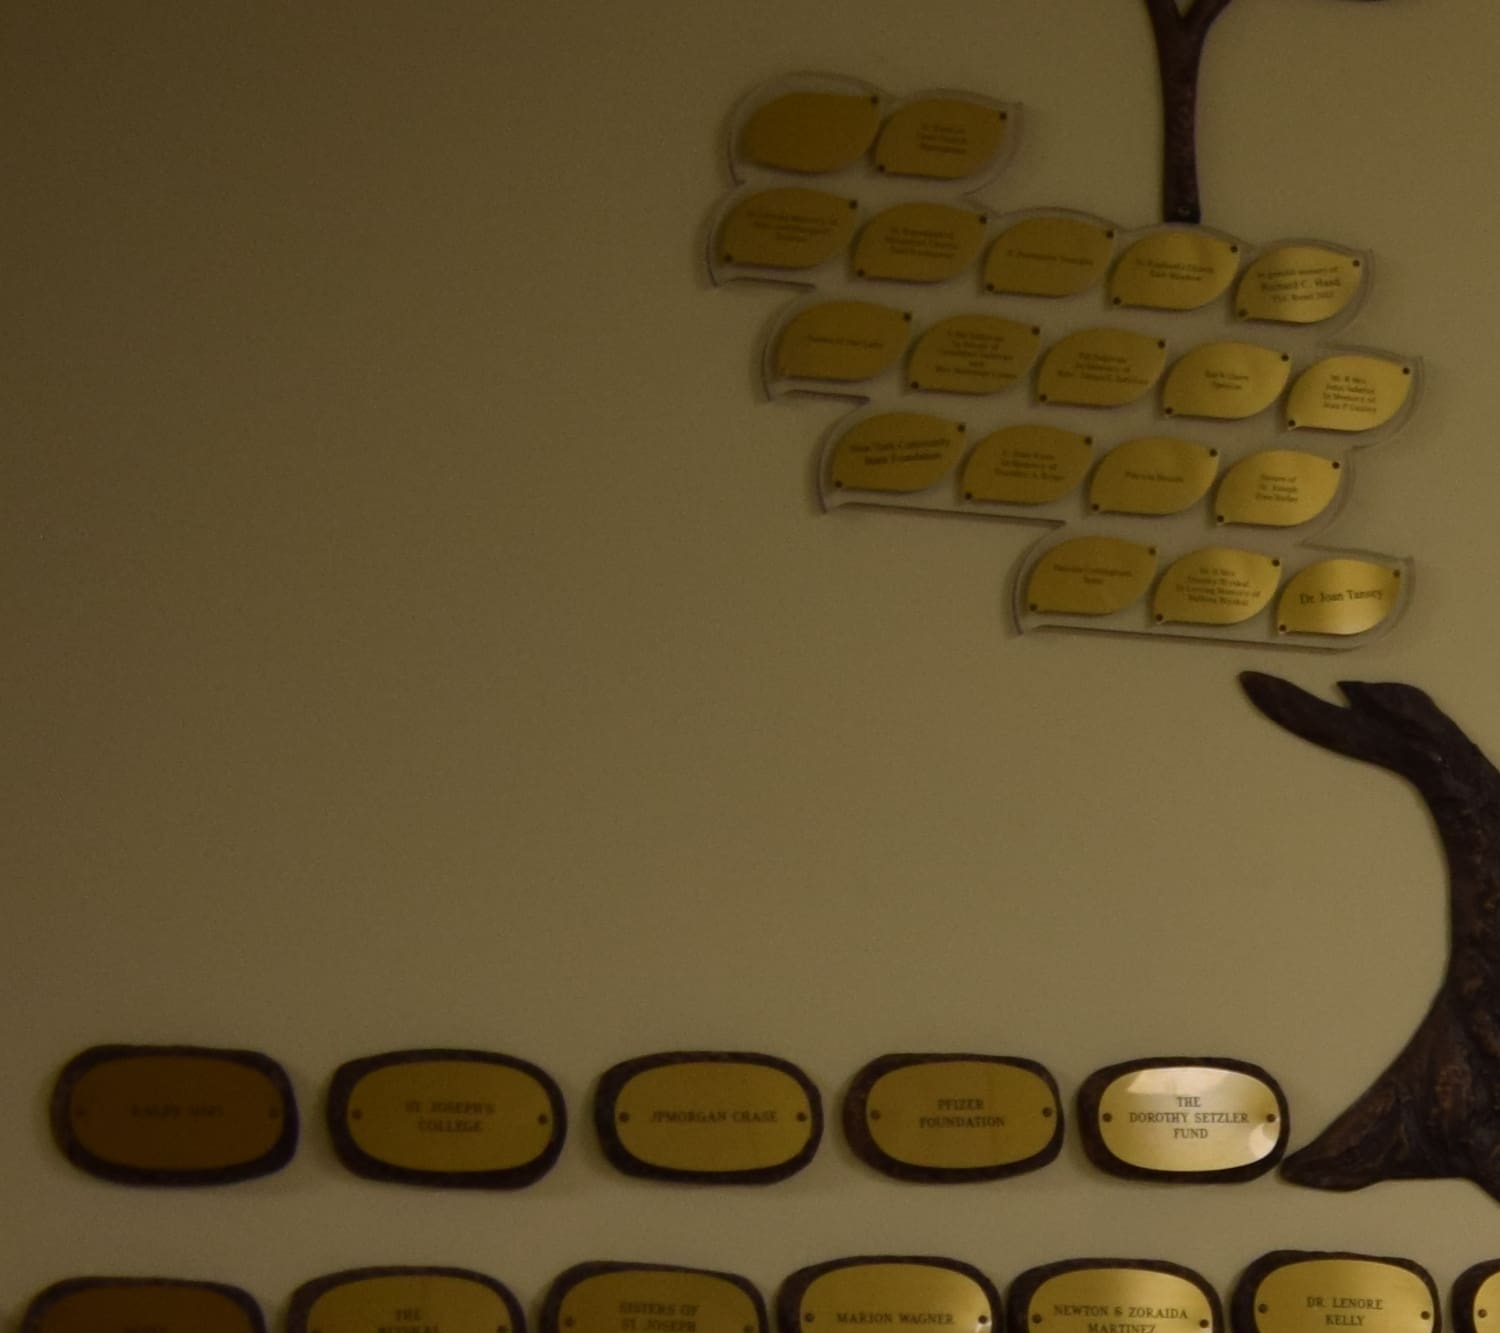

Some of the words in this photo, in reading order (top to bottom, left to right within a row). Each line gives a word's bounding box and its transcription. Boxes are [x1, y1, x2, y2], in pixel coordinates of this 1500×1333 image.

[1299, 592, 1315, 605] Dr.
[1319, 591, 1343, 602] Joan
[1347, 589, 1384, 600] Tansey
[1174, 1095, 1201, 1107] THE
[918, 1115, 1005, 1129] FOUNDATION
[1128, 1112, 1189, 1123] DOROTHY
[1194, 1112, 1250, 1124] SETZLER
[1173, 1128, 1208, 1139] FUND
[1332, 1296, 1383, 1310] LENORE
[836, 1311, 893, 1324] MARION
[898, 1312, 954, 1325] WAGNER
[1053, 1304, 1109, 1317] NEWTON
[1113, 1306, 1123, 1317] &
[1128, 1307, 1189, 1319] ZORAIDA
[1325, 1314, 1365, 1326] KELLY
